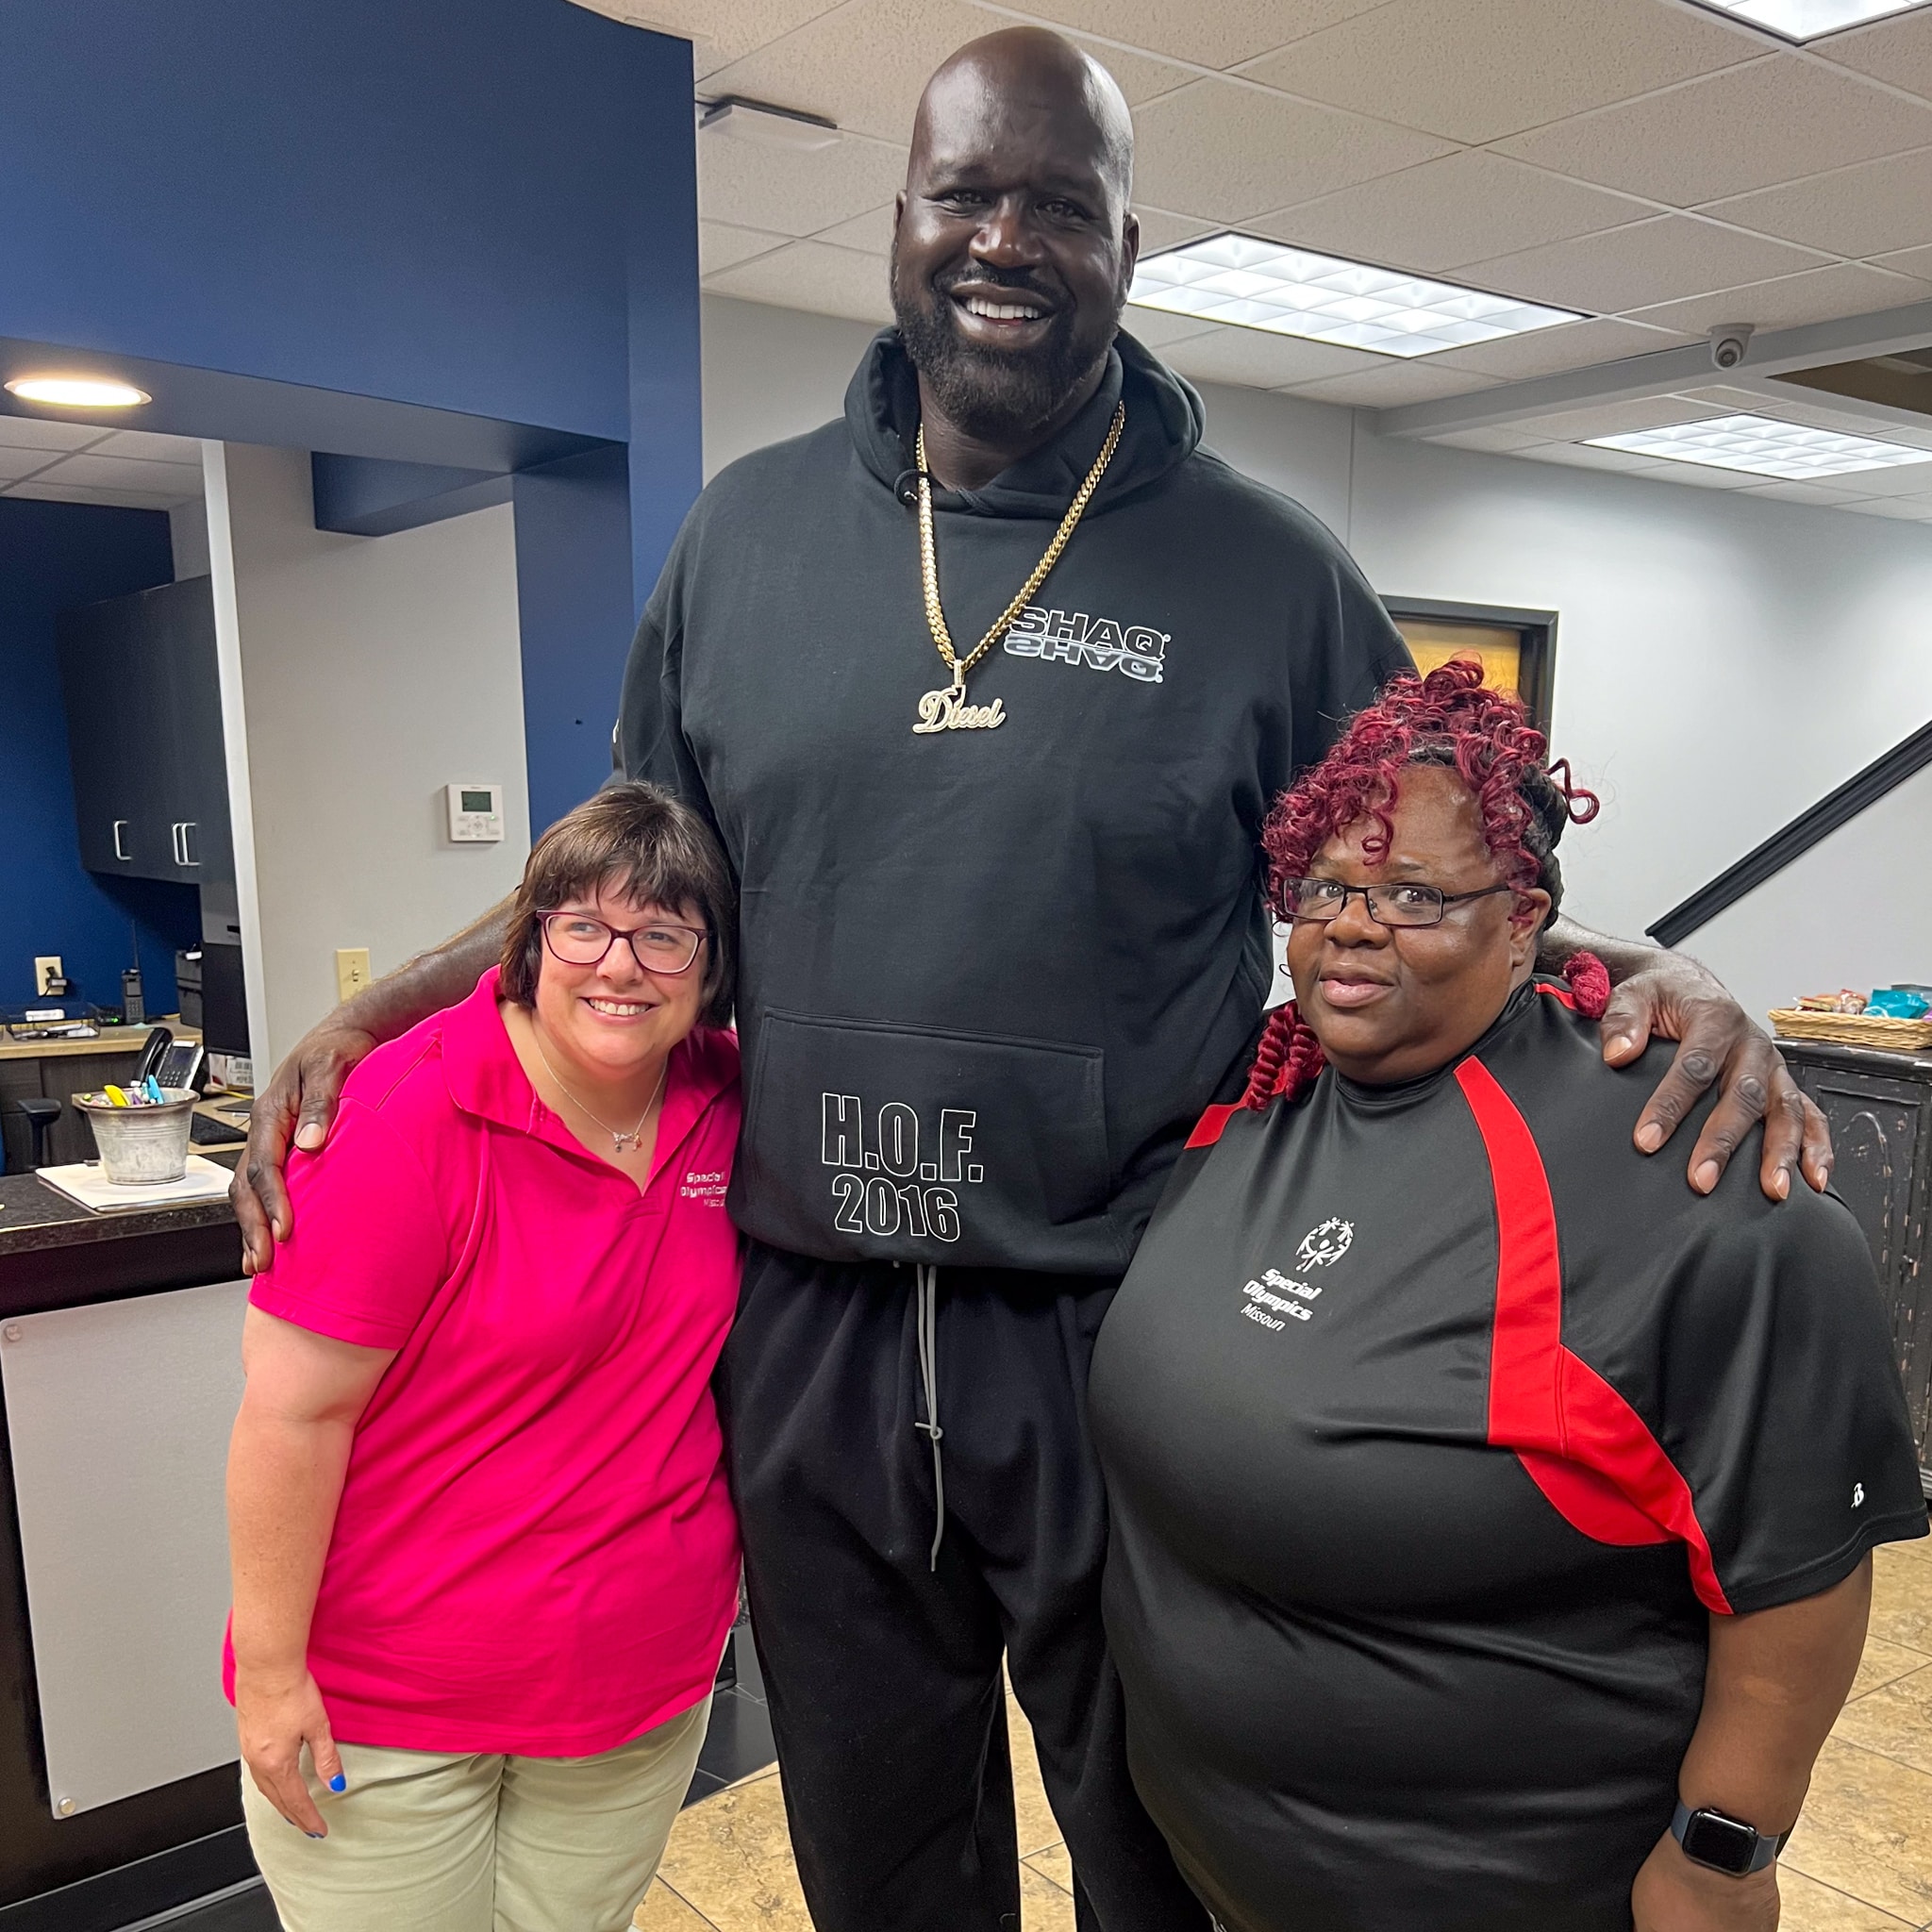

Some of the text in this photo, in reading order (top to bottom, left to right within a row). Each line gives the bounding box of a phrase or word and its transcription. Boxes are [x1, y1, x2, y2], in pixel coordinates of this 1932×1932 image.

[1009, 606, 1165, 662] SHAQ
[912, 685, 1007, 734] Diesel
[822, 1092, 984, 1183] H.O.F.
[832, 1173, 960, 1242] 2016
[1242, 1279, 1313, 1321] Olympics
[1261, 1268, 1323, 1300] Special
